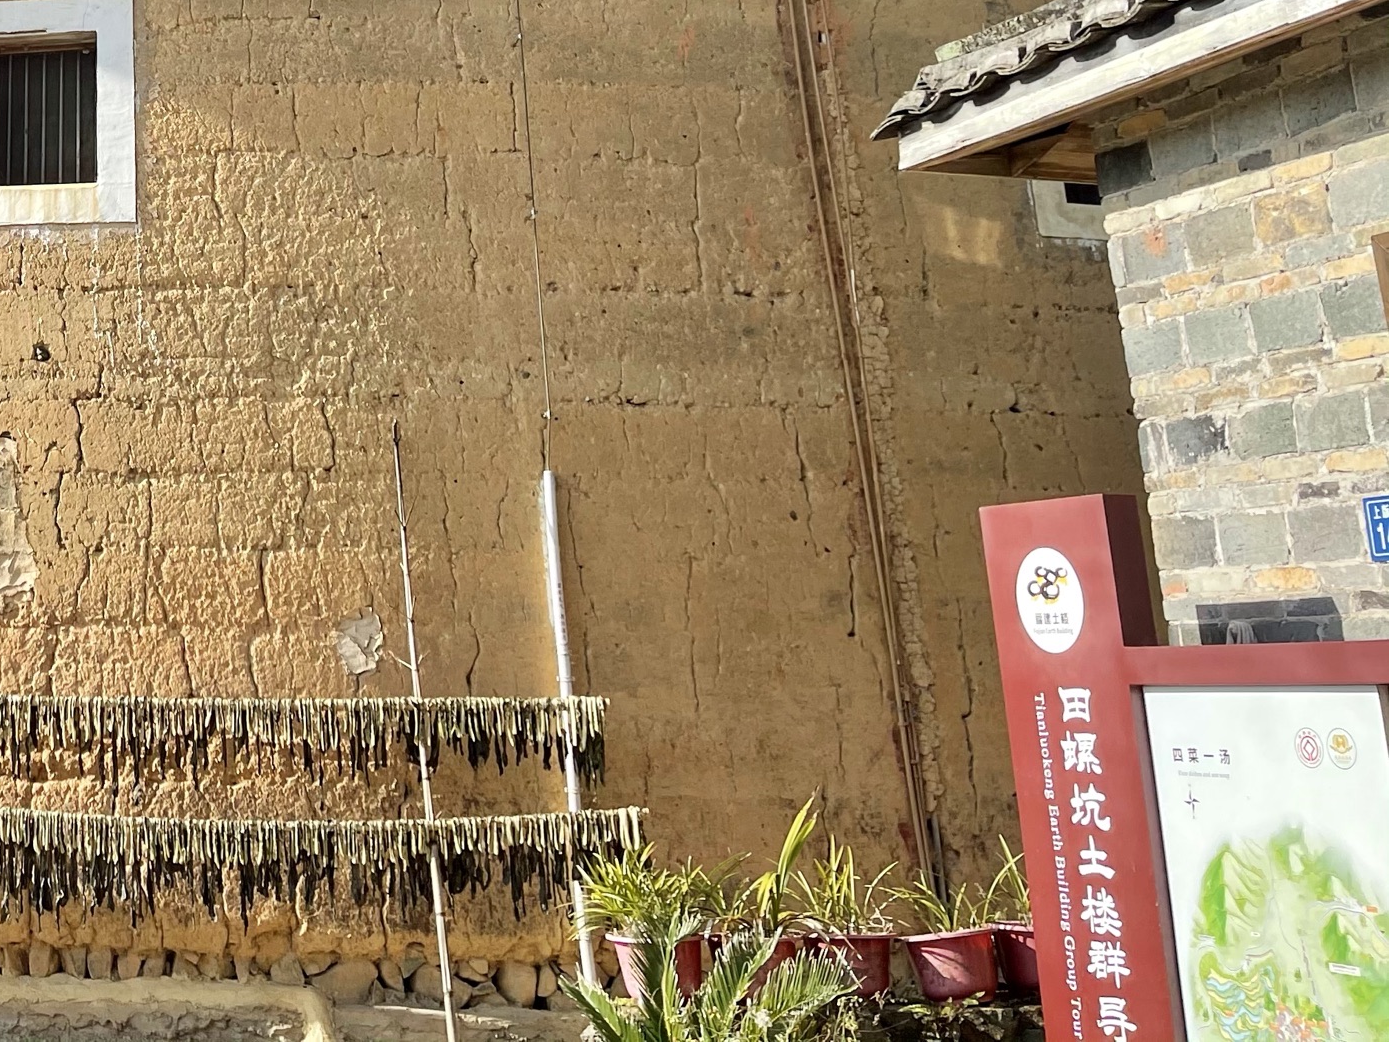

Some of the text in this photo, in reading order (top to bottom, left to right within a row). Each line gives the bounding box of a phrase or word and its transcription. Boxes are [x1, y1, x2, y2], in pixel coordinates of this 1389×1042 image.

[1172, 747, 1231, 765] 四菜一汤
[1048, 804, 1064, 851] Earth
[1054, 855, 1072, 932] Building
[1064, 935, 1078, 991] Group
[1070, 997, 1083, 1040] Tour
